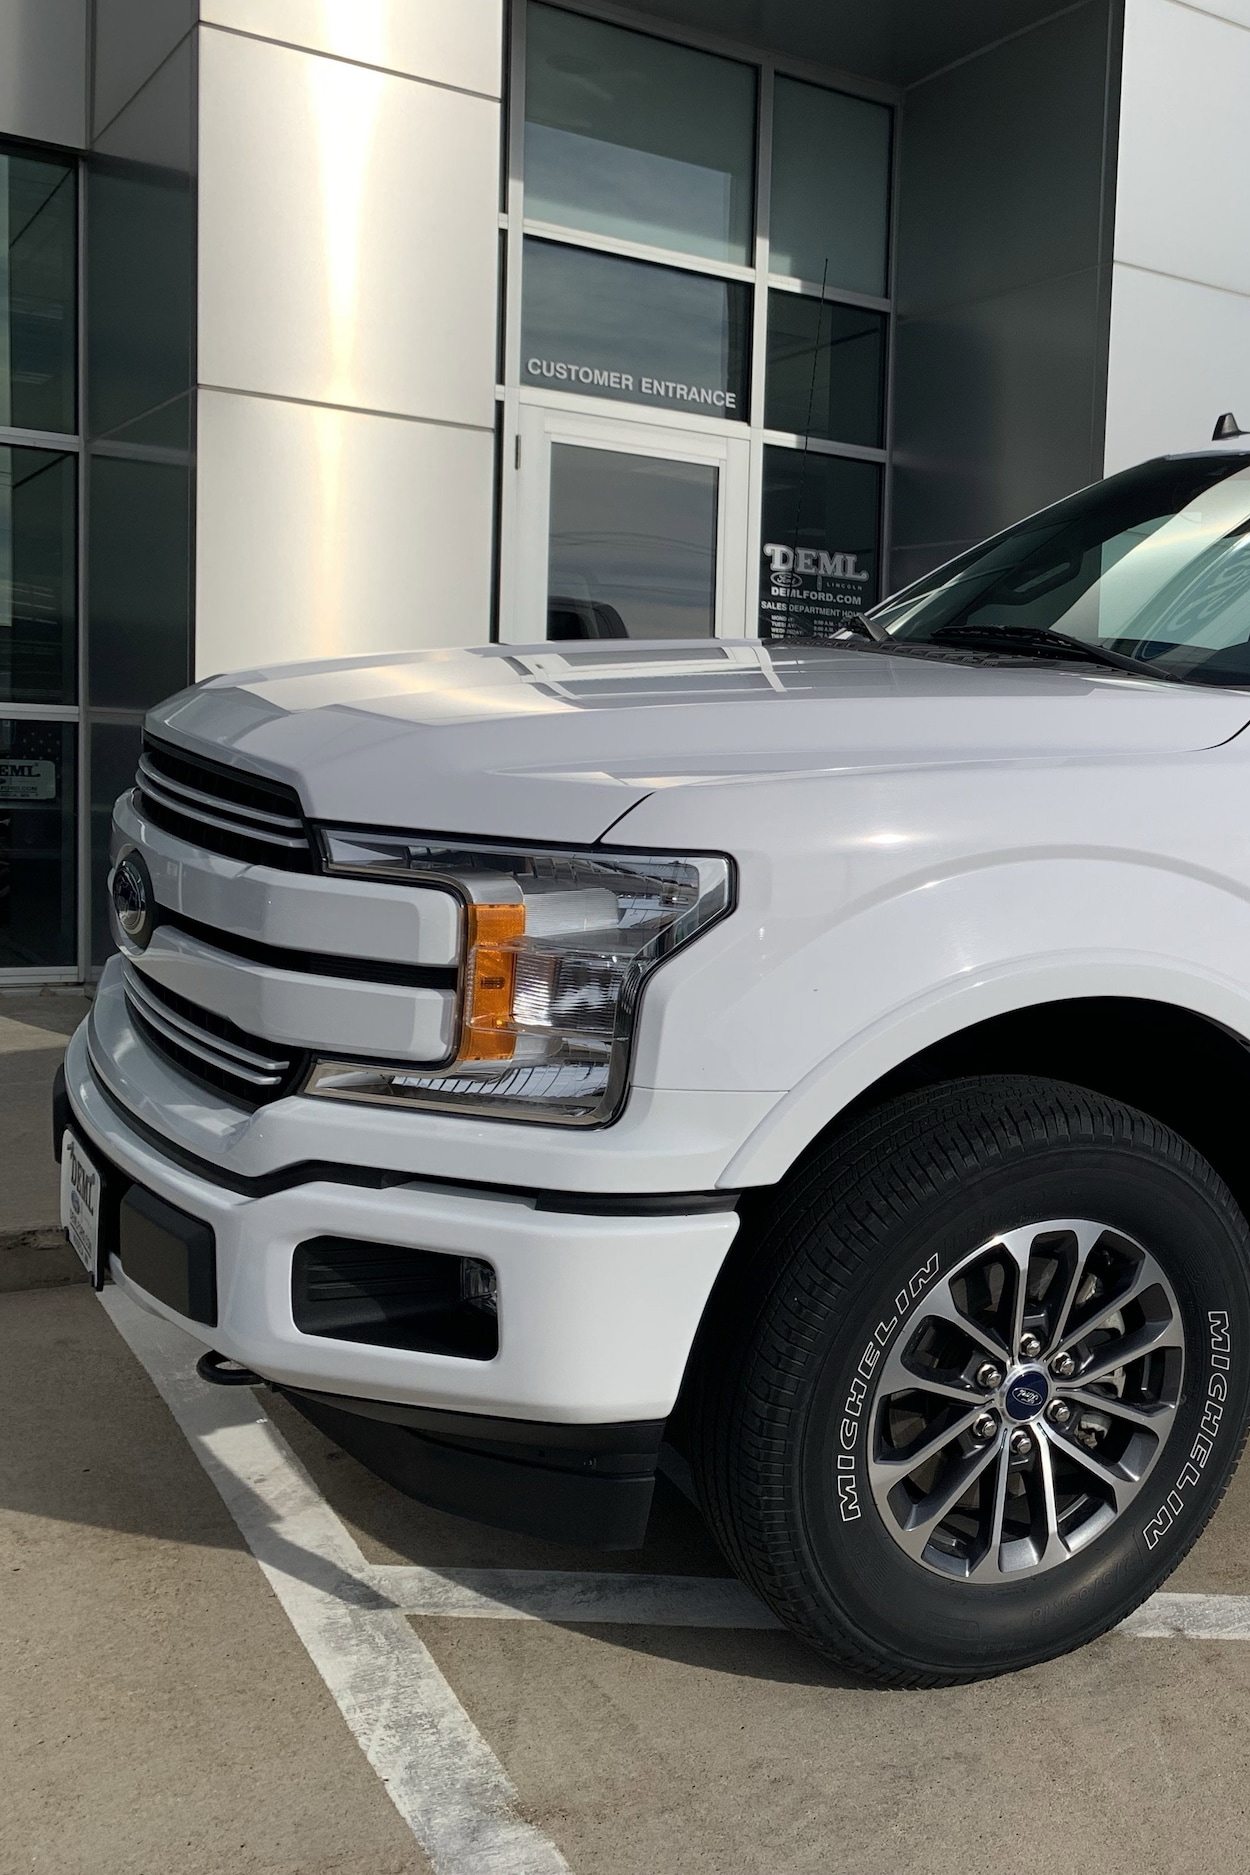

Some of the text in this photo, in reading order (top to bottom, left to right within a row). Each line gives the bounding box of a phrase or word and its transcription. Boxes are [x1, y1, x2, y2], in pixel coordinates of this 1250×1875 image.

[527, 358, 737, 409] CUSTOMER ENTRANCE
[763, 543, 869, 582] DEML
[771, 586, 861, 606] DEMLFORD.COM
[826, 582, 863, 590] LINCOLN
[761, 601, 787, 611] SALES
[788, 604, 841, 617] DEPARTMENT
[836, 1252, 941, 1523] MICHELIN
[1017, 1389, 1039, 1404] Ford
[1142, 1310, 1232, 1550] MICHELIN
